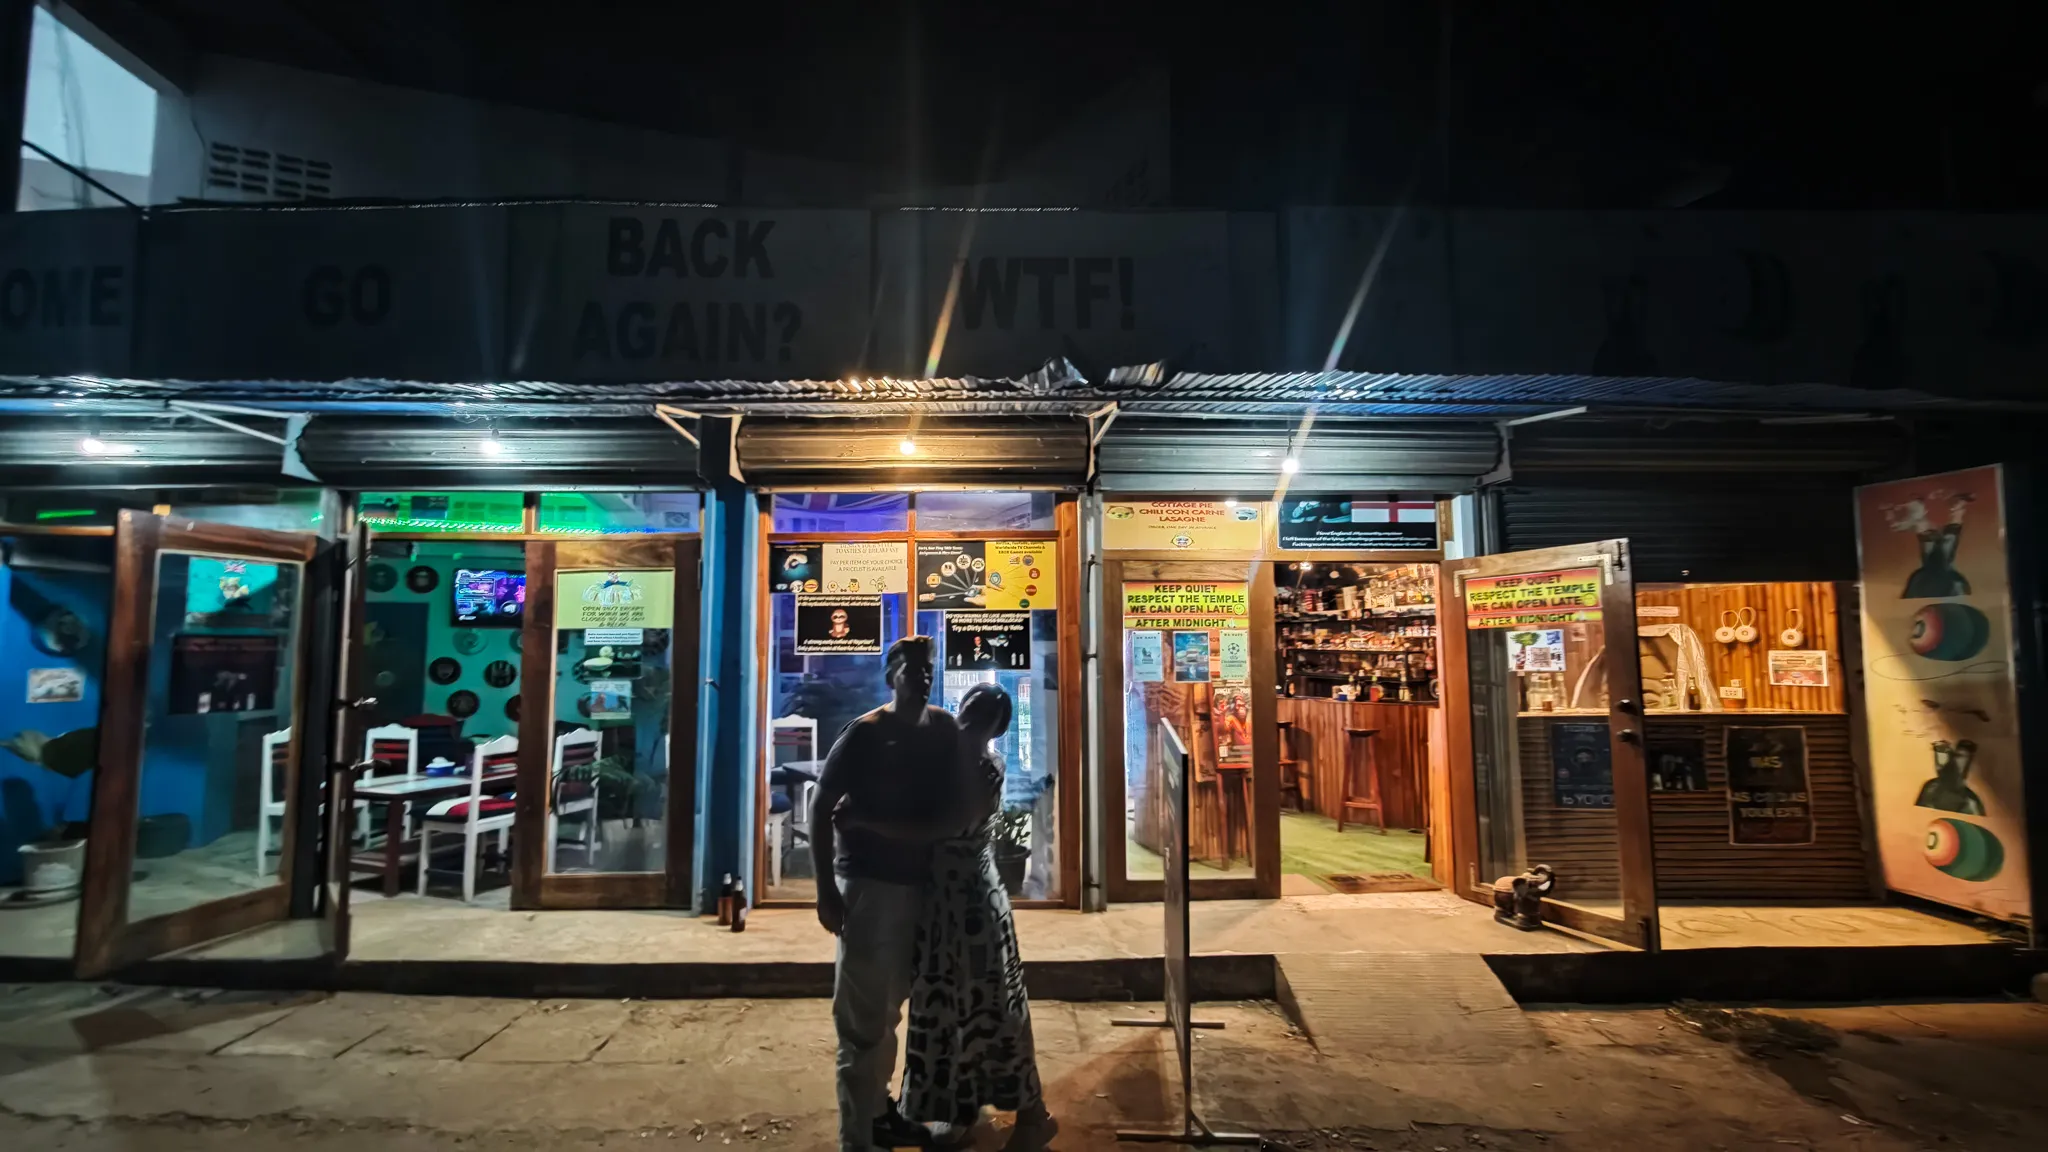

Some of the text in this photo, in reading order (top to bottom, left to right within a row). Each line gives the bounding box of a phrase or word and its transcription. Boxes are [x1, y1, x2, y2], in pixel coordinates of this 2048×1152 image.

[607, 218, 776, 279] BACK
[304, 265, 391, 326] GO
[959, 257, 1138, 331] WTF!
[573, 301, 803, 362] AGAIN?
[1154, 584, 1218, 593] KEEP QUIET
[1495, 574, 1562, 588] KEEP QUIET
[1127, 595, 1245, 603] RESPECT THE TEMPLE
[1469, 583, 1596, 602] RESPECT THE TEMPLE
[1130, 605, 1233, 613] WE CAN OPEN LATE
[1472, 596, 1582, 612] WE CAN OPEN LATE
[1135, 618, 1226, 627] AFTER MIDNIGHT
[1478, 612, 1574, 627] AFTER MIDNIGHT
